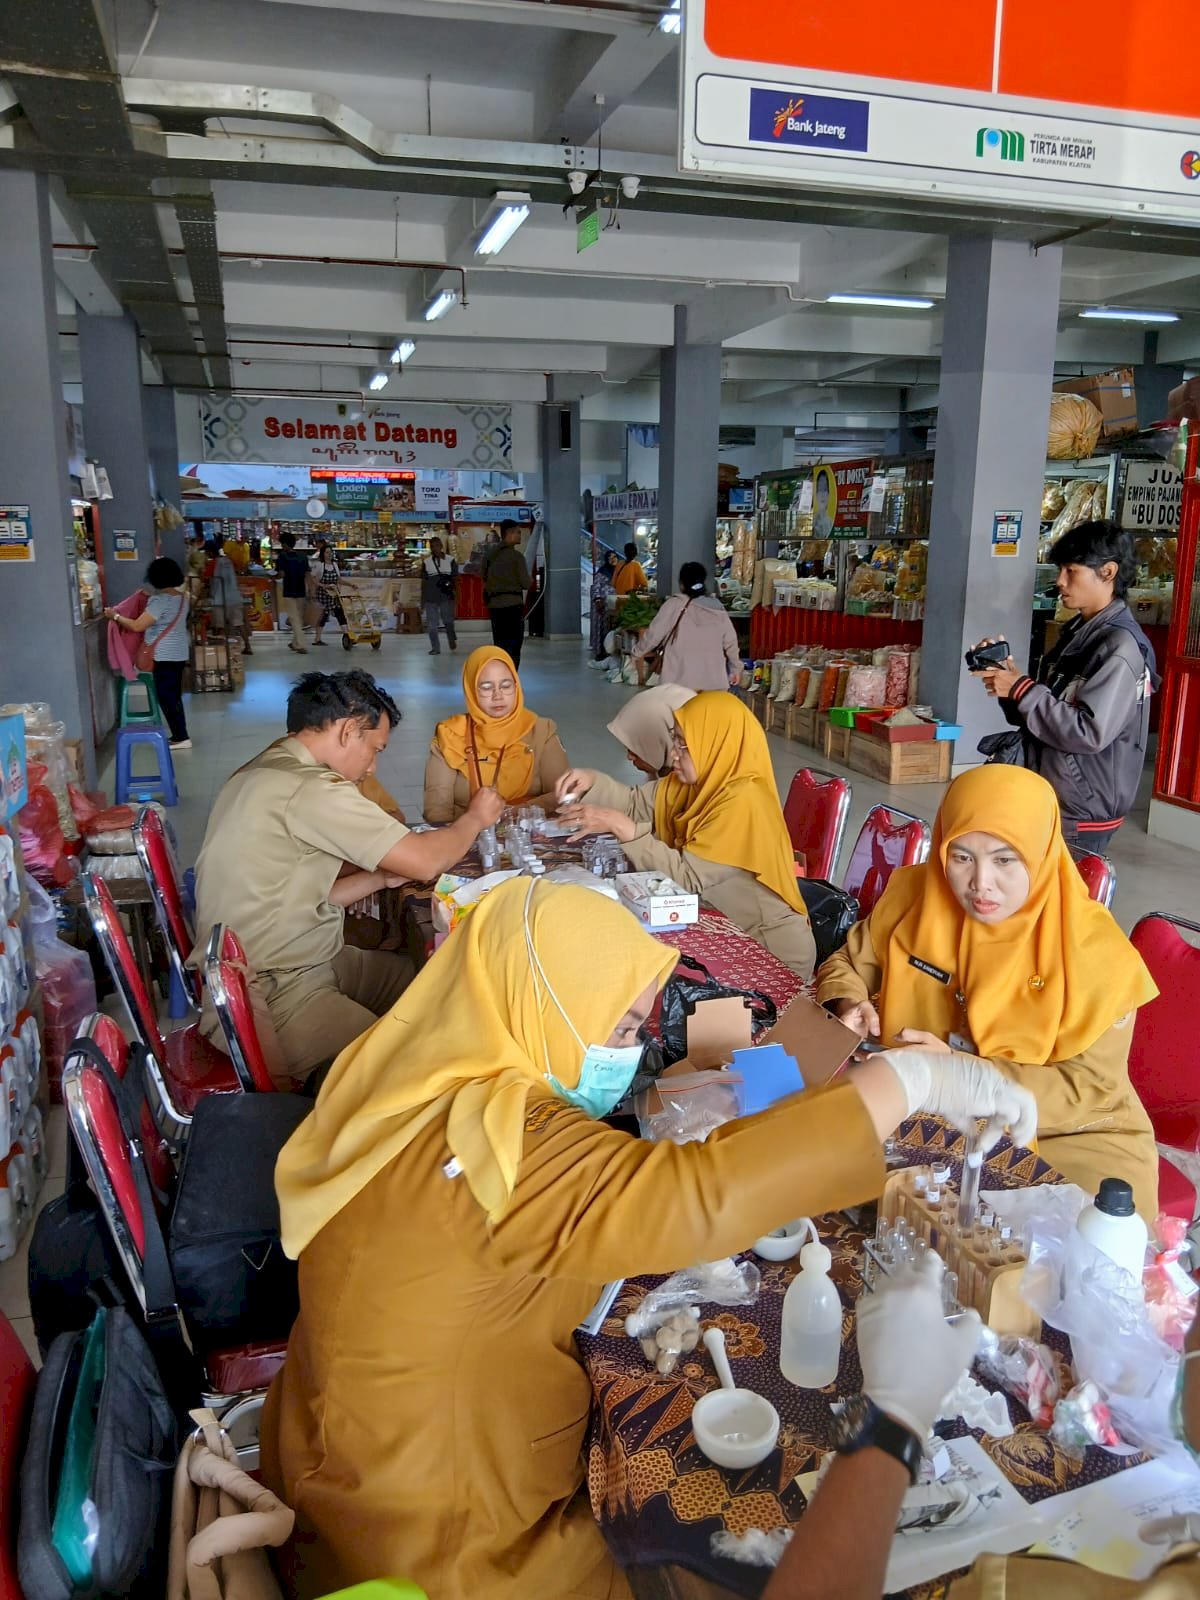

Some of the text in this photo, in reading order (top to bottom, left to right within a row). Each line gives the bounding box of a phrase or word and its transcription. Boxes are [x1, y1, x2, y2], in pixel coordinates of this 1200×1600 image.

[787, 117, 847, 140] Bank Jateng
[1030, 140, 1096, 160] TIRTA MERAPI
[1032, 157, 1091, 169] KABUPATEN KLATEN
[264, 416, 458, 449] Selamat Datang
[628, 492, 649, 510] ERNA
[1128, 486, 1183, 502] EMPING PAJAN
